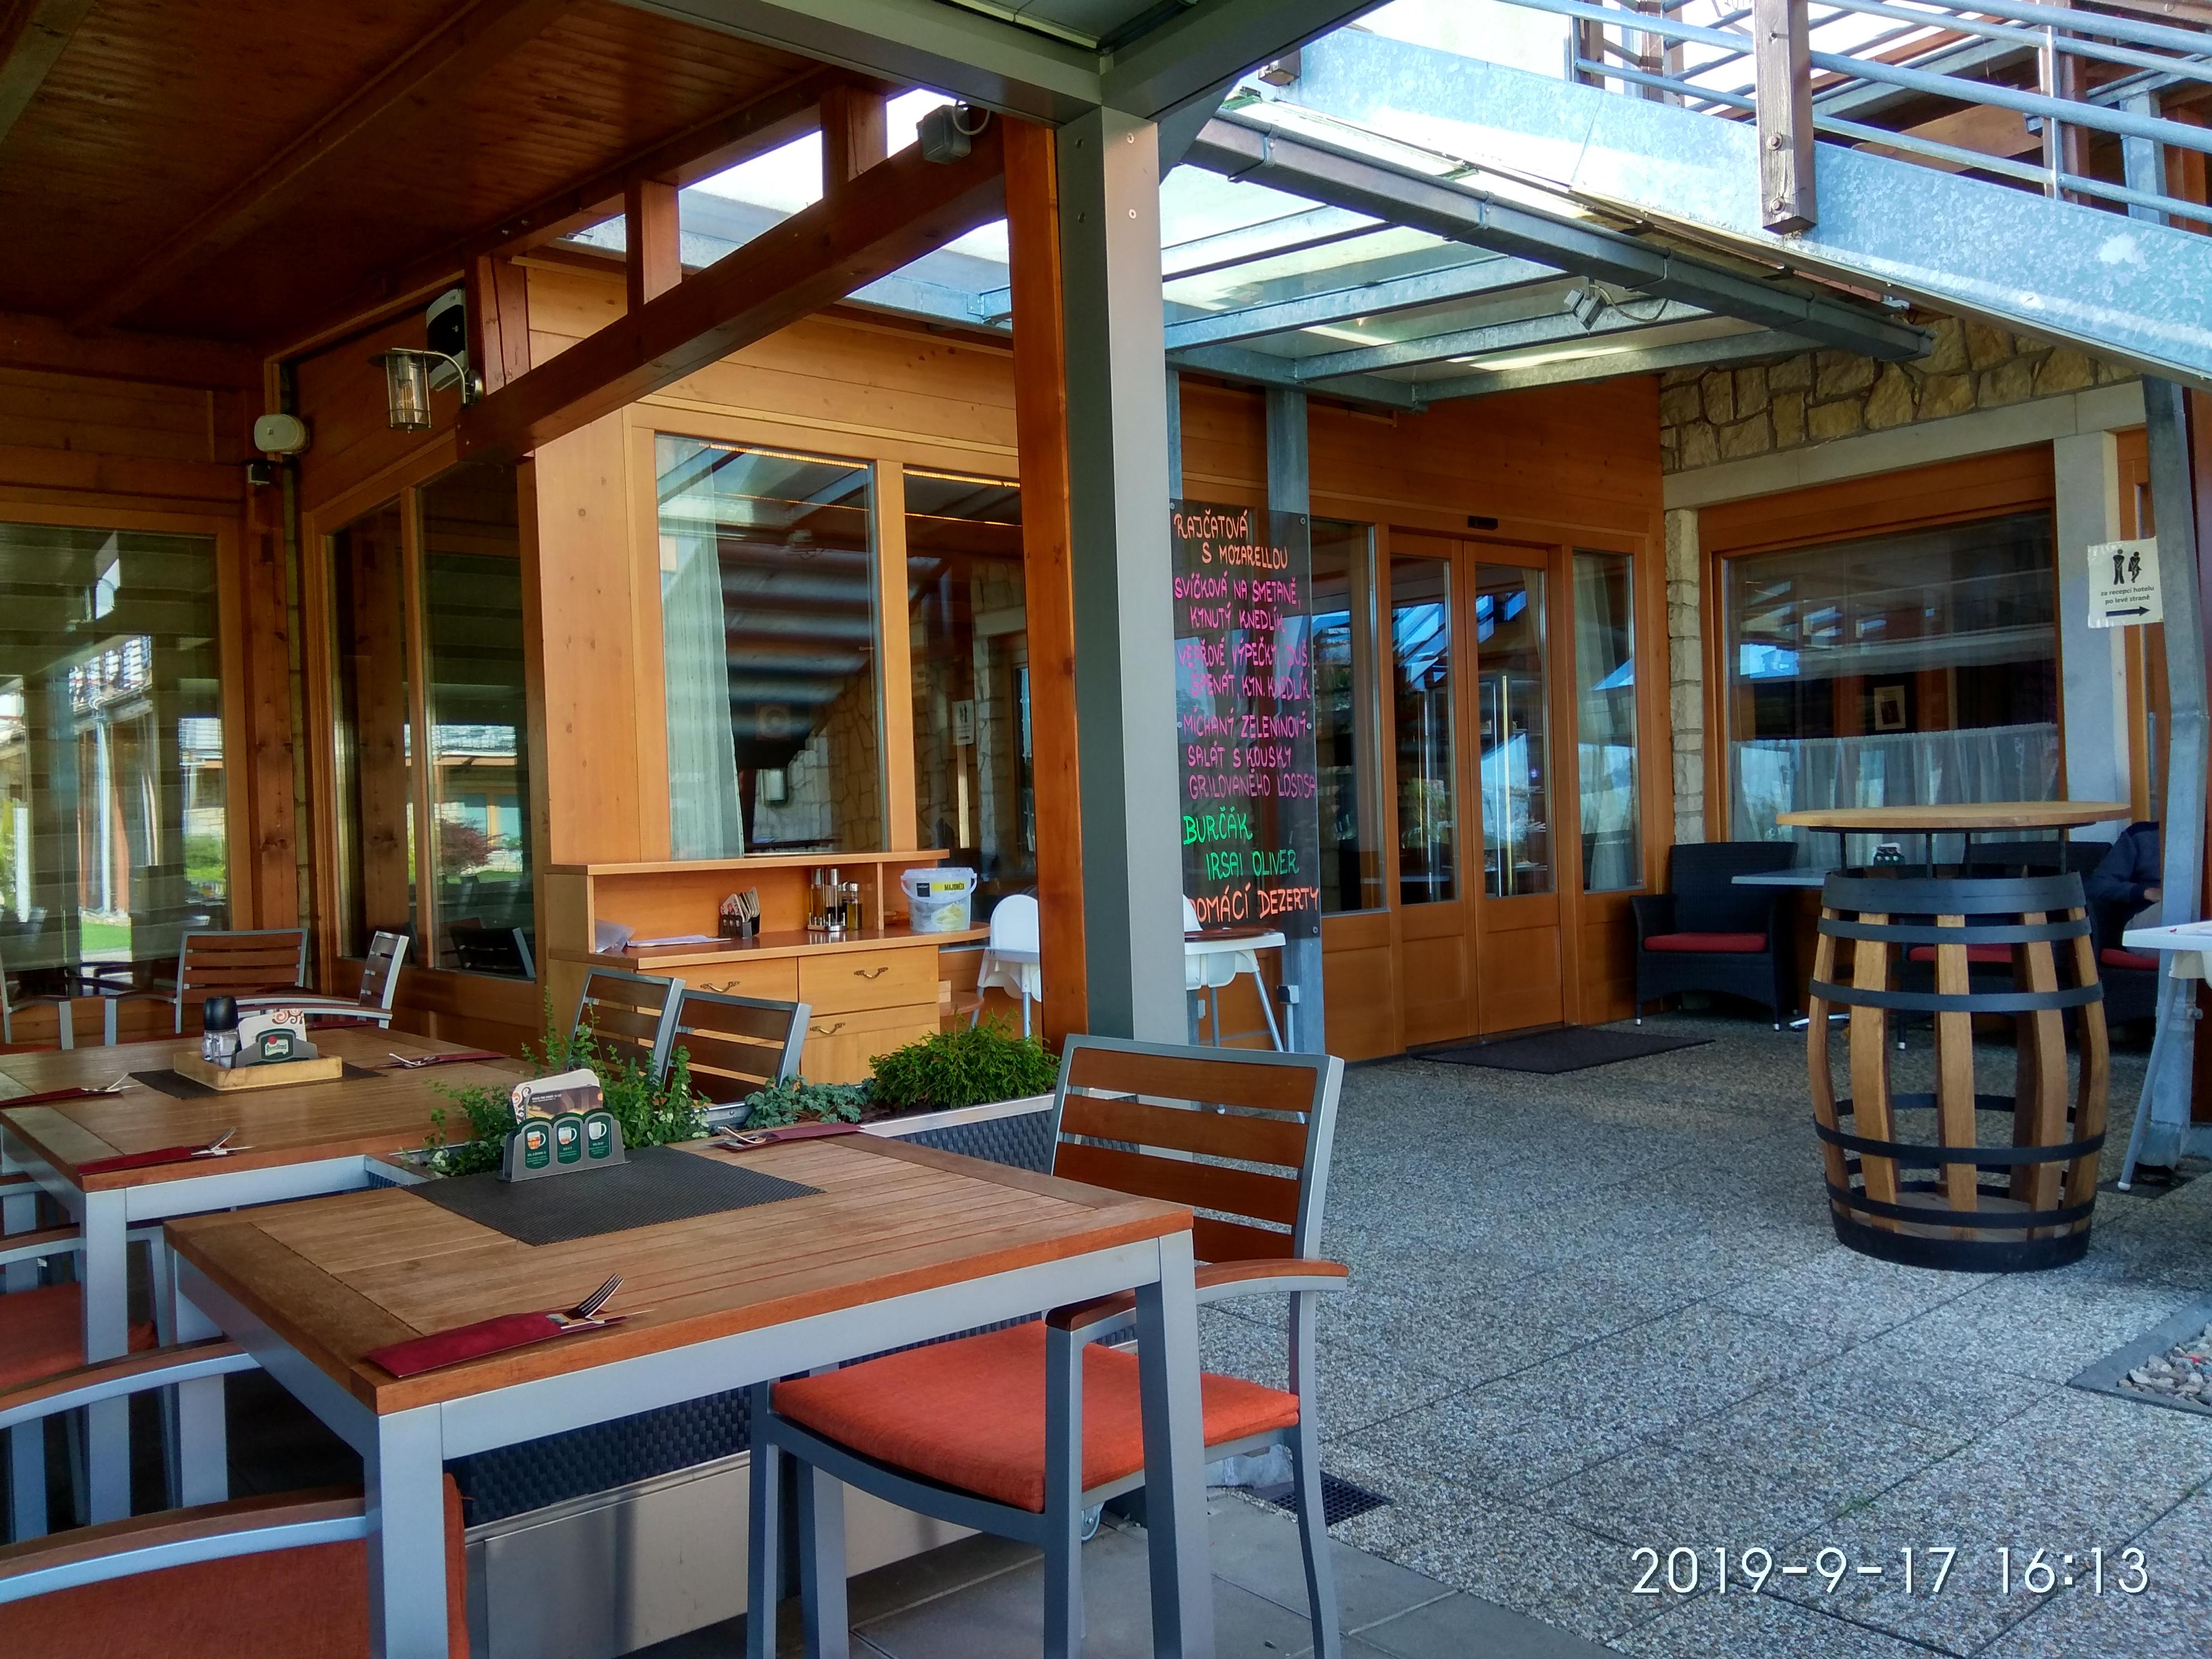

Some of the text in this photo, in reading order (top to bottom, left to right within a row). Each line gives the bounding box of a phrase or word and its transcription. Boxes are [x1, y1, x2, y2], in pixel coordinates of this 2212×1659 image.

[1173, 508, 1248, 540] RAJČATOVÁ
[1202, 541, 1288, 570] S MOZARELLOU
[1175, 571, 1301, 611] SVÍČKOVÁ NA SMETANĚ,
[1190, 602, 1286, 633] KYNUTÝ KNEDLÍK
[1177, 637, 1225, 667] VEPŘOVÉ
[1232, 635, 1277, 666] VÝPEČKY
[1183, 707, 1306, 738] MÍCHANÝ ZELENINOVÝ
[1188, 740, 1292, 769] SALÁT S KOUSKY
[1190, 768, 1316, 800] GRILOVANÉHO LOSOSA
[1183, 806, 1253, 845] BURČÁK
[1206, 849, 1299, 880] IRSAI OLIVER
[1257, 886, 1319, 919] DEZERTY
